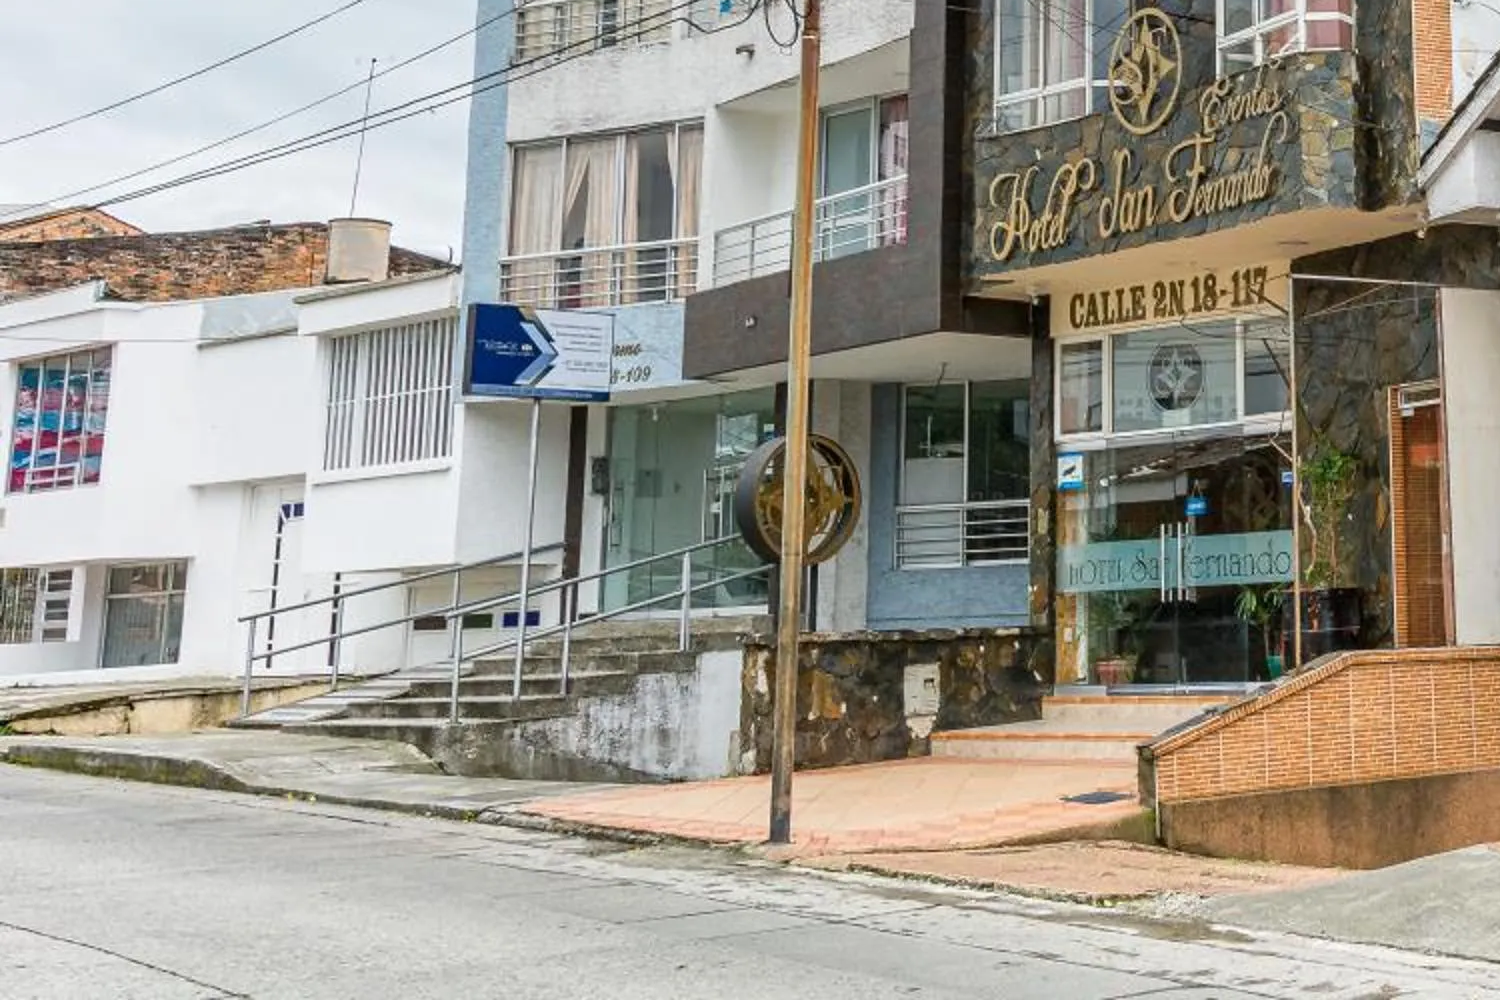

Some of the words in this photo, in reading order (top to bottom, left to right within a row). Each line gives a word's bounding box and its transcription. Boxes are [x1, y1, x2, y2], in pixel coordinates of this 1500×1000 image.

[1202, 60, 1283, 133] Eventos
[989, 158, 1096, 261] Hotel
[1099, 149, 1158, 237] San
[1166, 111, 1288, 223] Fernando
[1070, 286, 1145, 330] CALLE
[1153, 280, 1185, 320] 2N
[1193, 266, 1267, 312] 18-117
